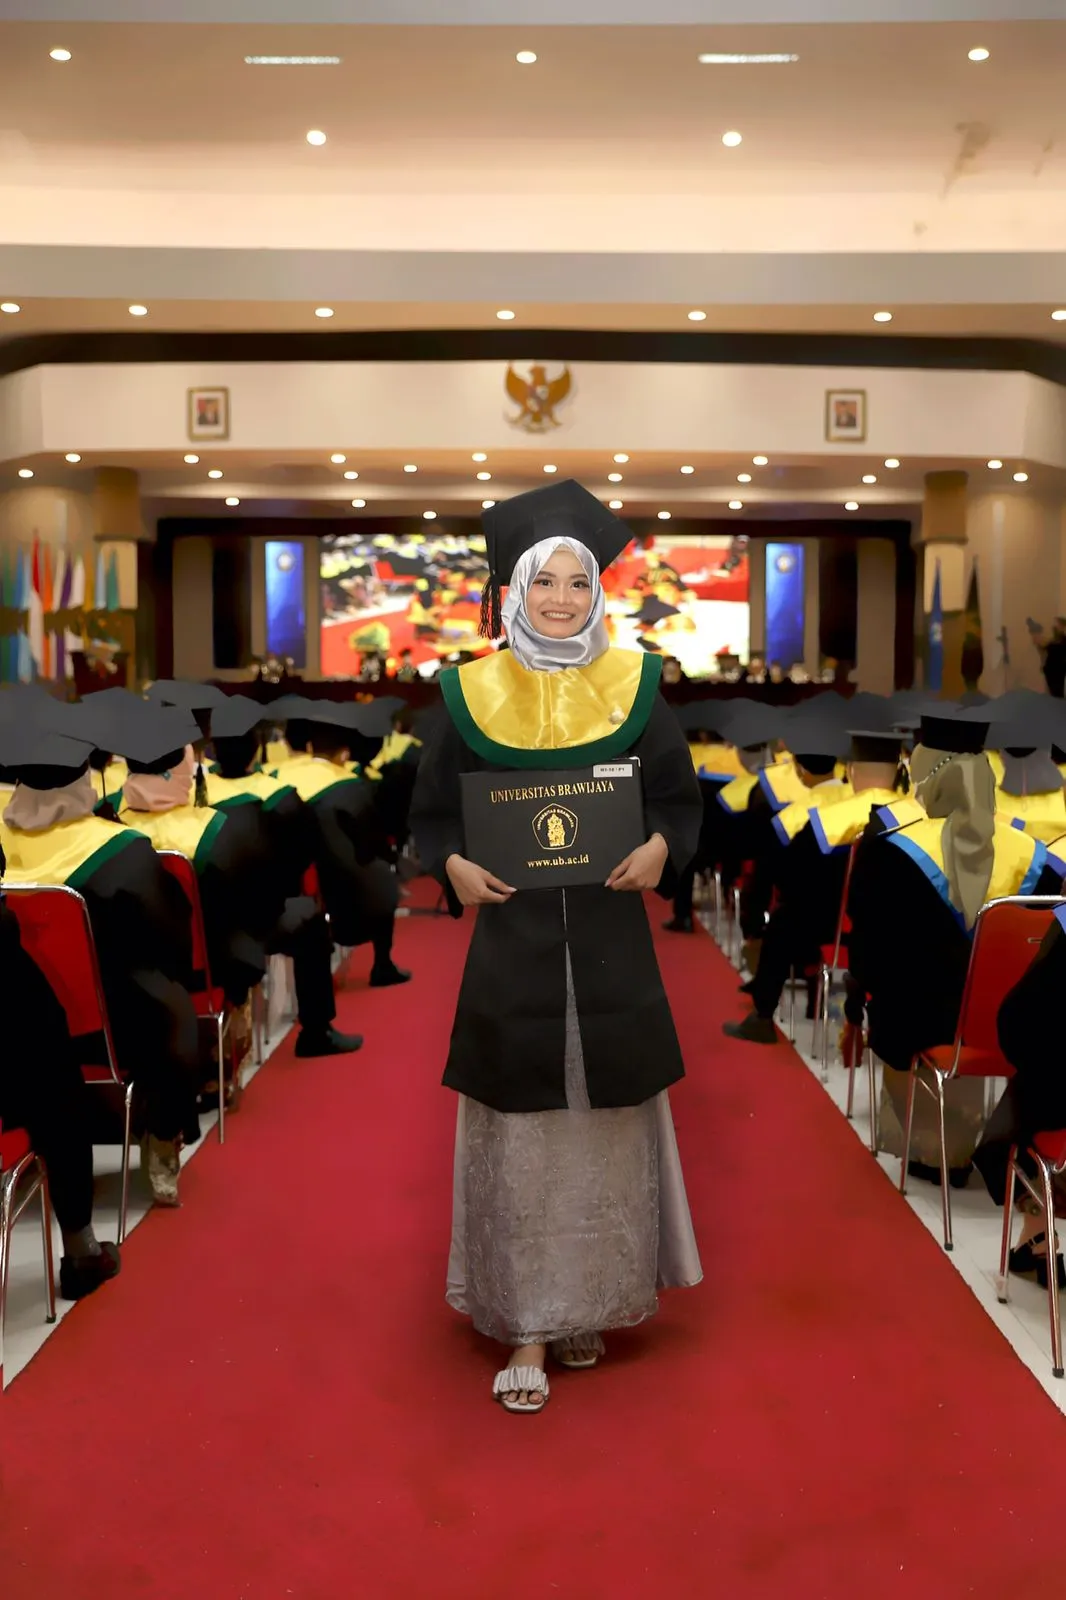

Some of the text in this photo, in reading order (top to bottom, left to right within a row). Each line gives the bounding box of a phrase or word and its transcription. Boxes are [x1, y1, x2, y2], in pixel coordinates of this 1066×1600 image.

[490, 780, 614, 803] UNIVERSITAS BRAWIJAYA
[527, 854, 589, 868] www.ub.ac.id
